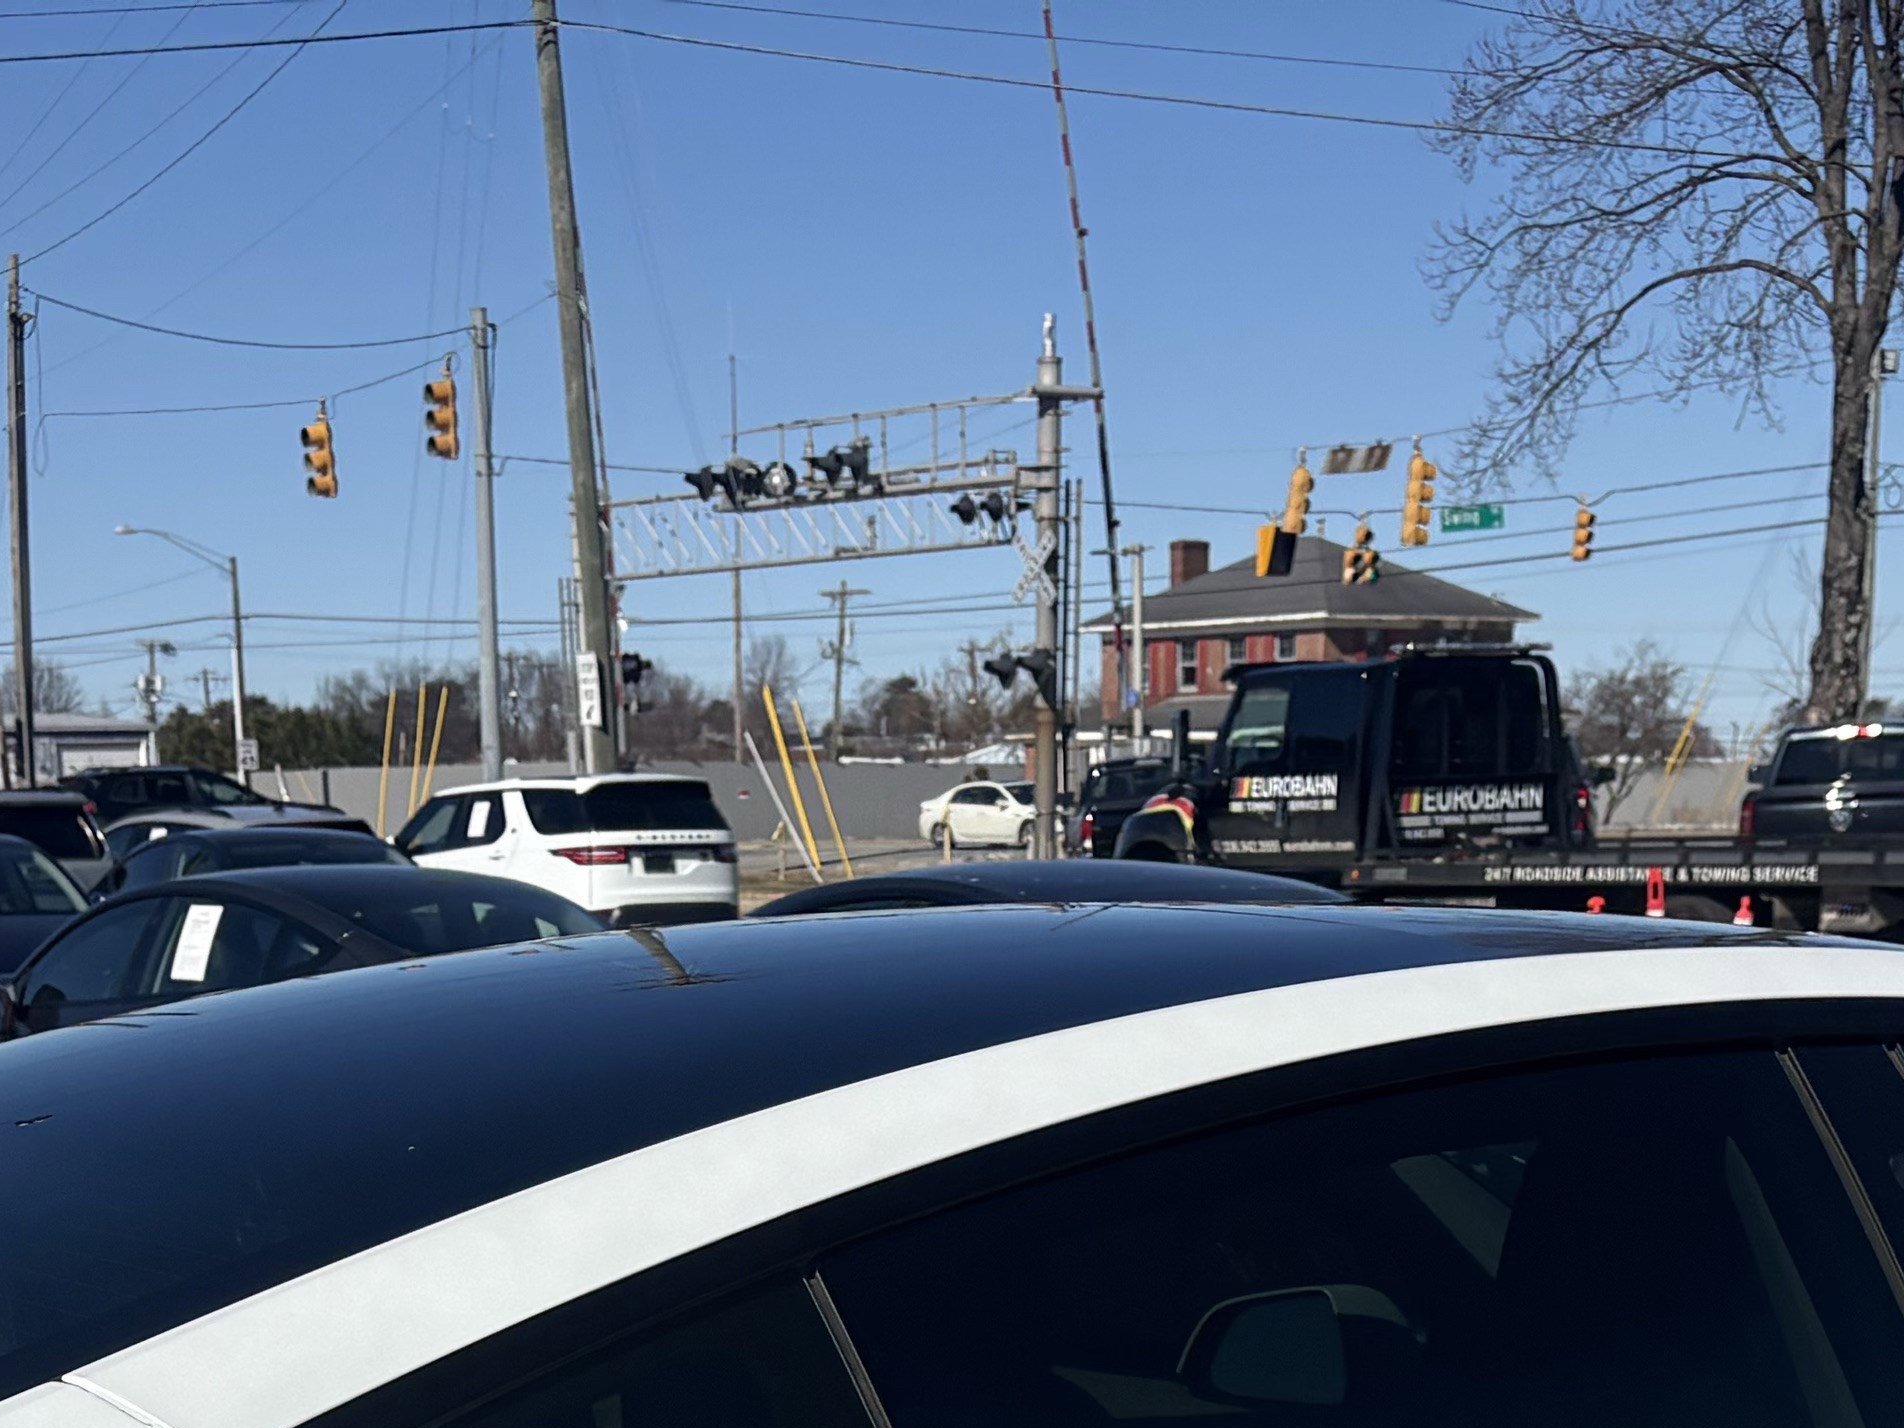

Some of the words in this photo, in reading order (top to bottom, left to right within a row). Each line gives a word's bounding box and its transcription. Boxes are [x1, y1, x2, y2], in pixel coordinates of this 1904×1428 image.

[1250, 775, 1338, 798] EUROBAHN
[1422, 783, 1544, 812] EUROBAHN
[1513, 866, 1584, 881] ROADSIDE
[1691, 866, 1749, 882] TOWING
[1752, 865, 1819, 882] SERVICE
